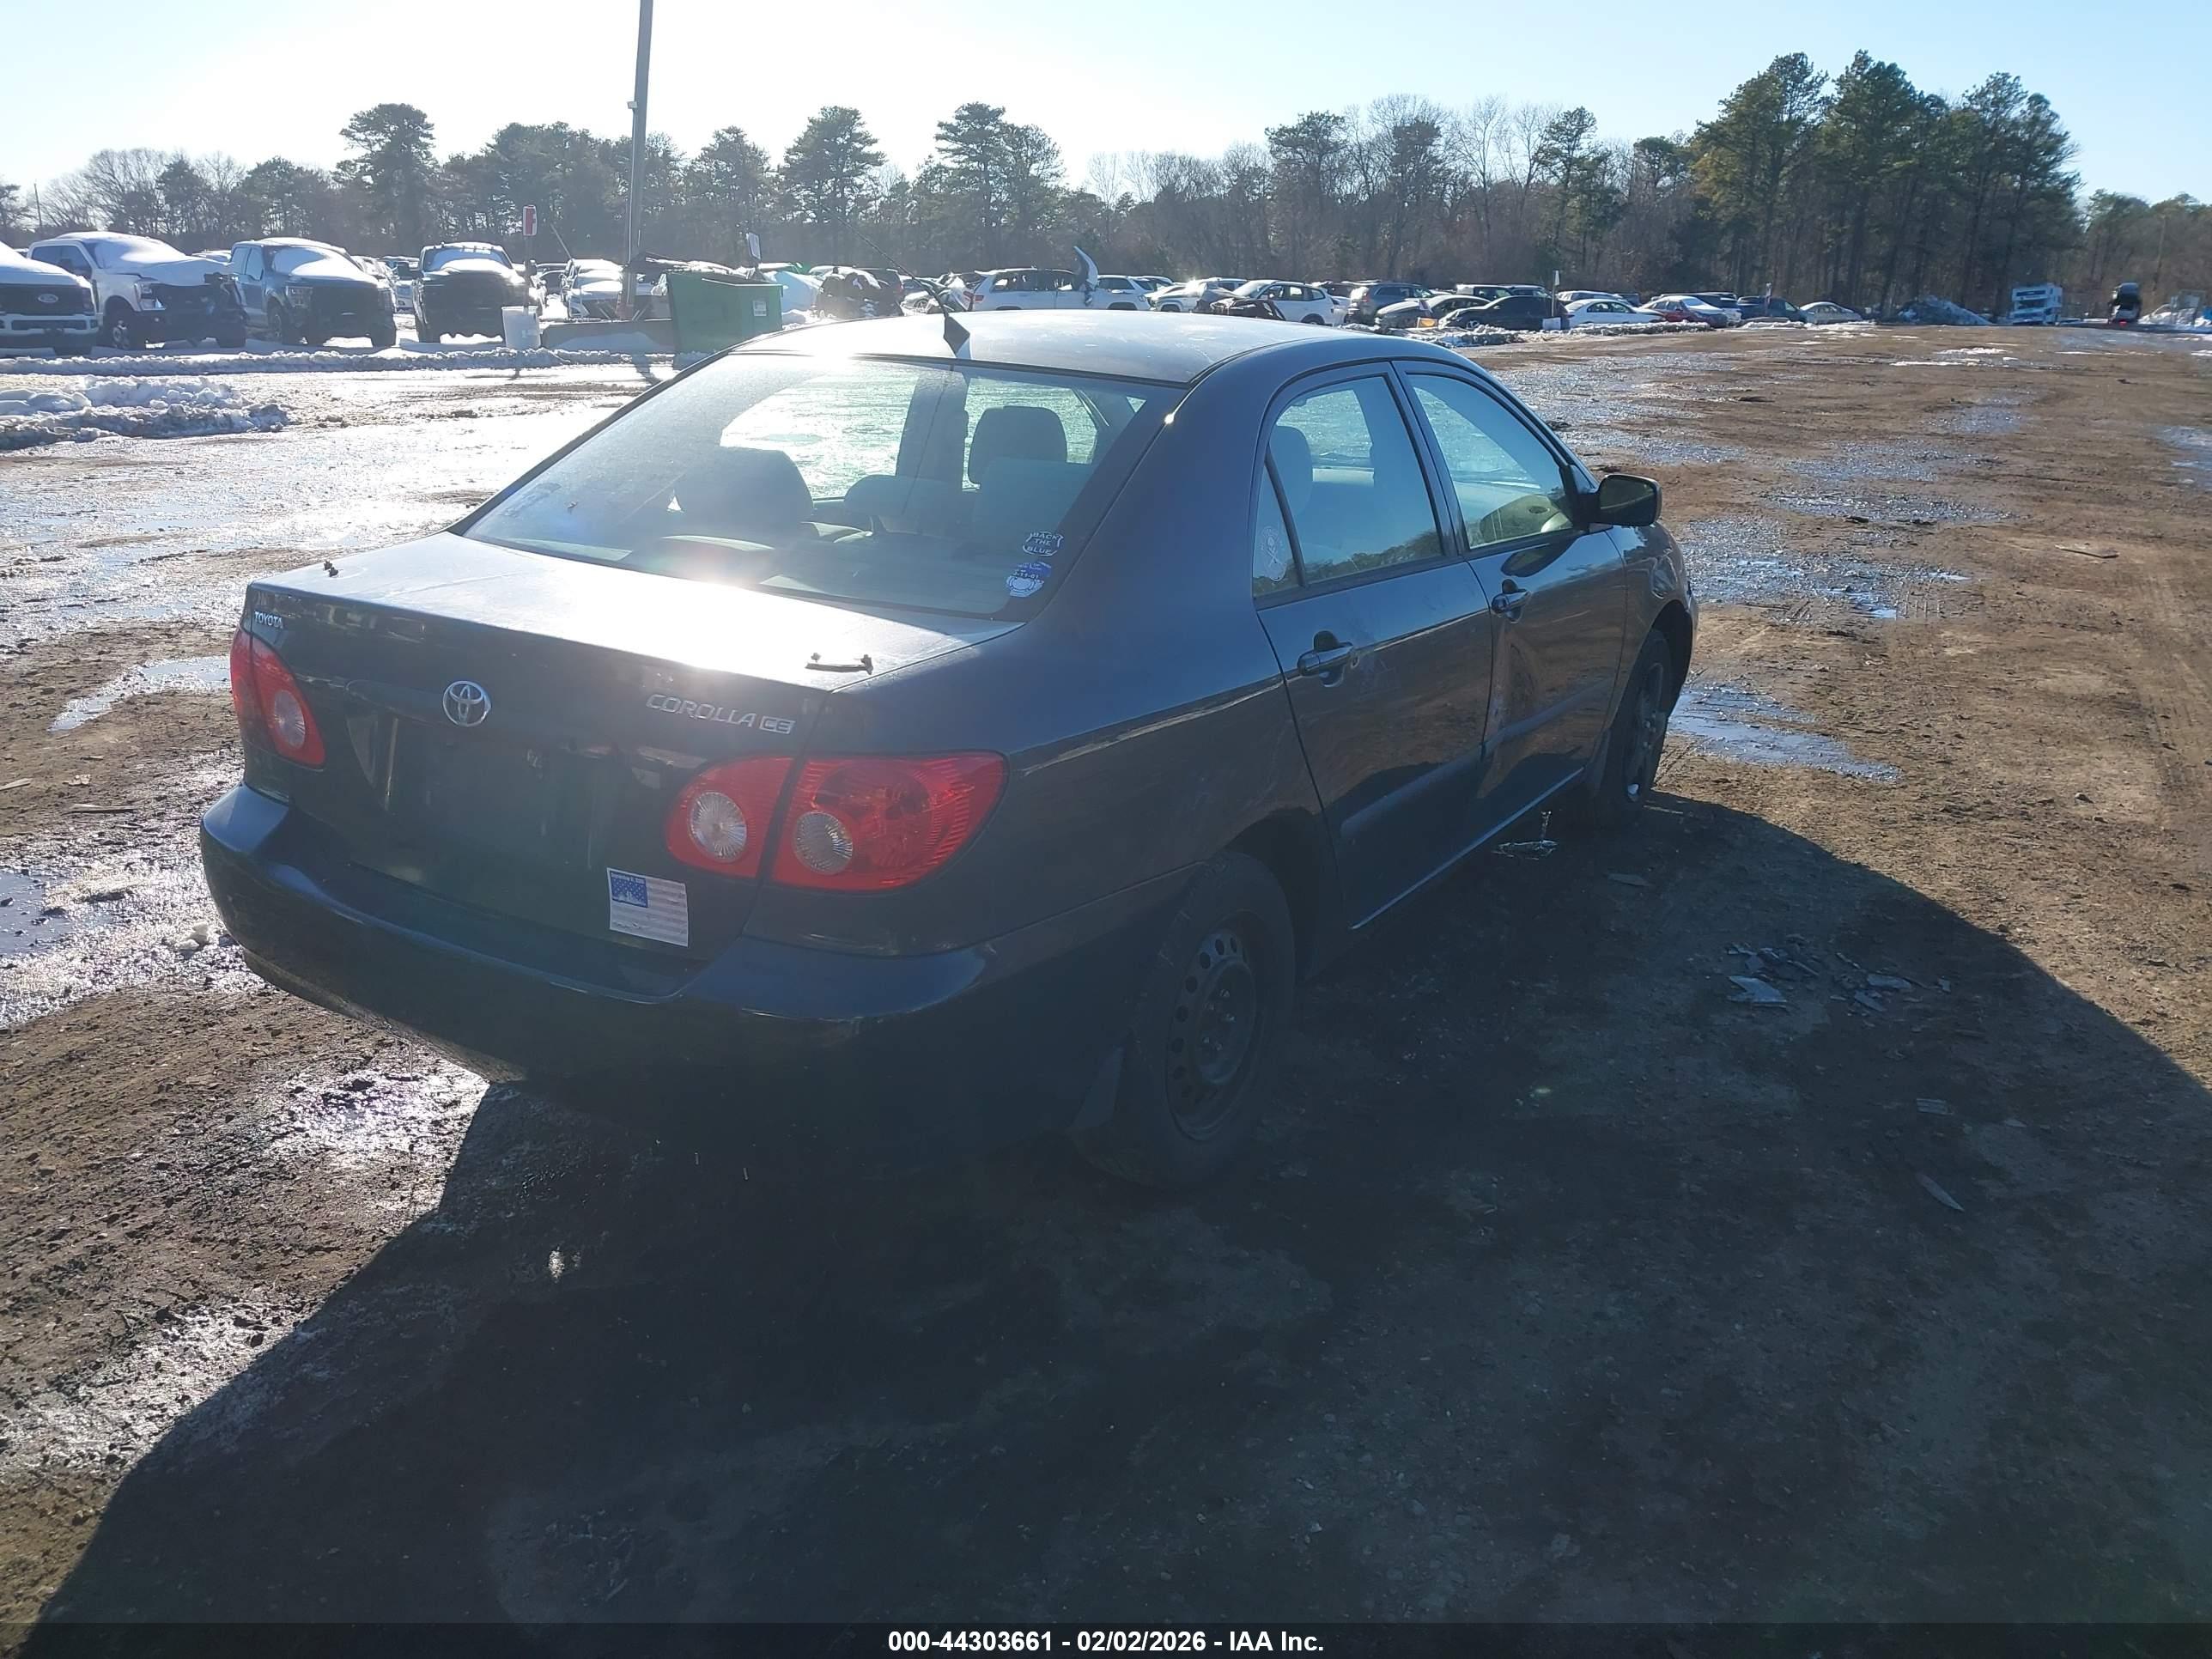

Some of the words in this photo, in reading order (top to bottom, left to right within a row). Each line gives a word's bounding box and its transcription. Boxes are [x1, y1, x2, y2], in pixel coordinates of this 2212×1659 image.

[1026, 546, 1052, 555] BLUE
[254, 611, 283, 629] TOYOTA
[646, 694, 757, 727] COROLLA
[760, 716, 794, 734] CE
